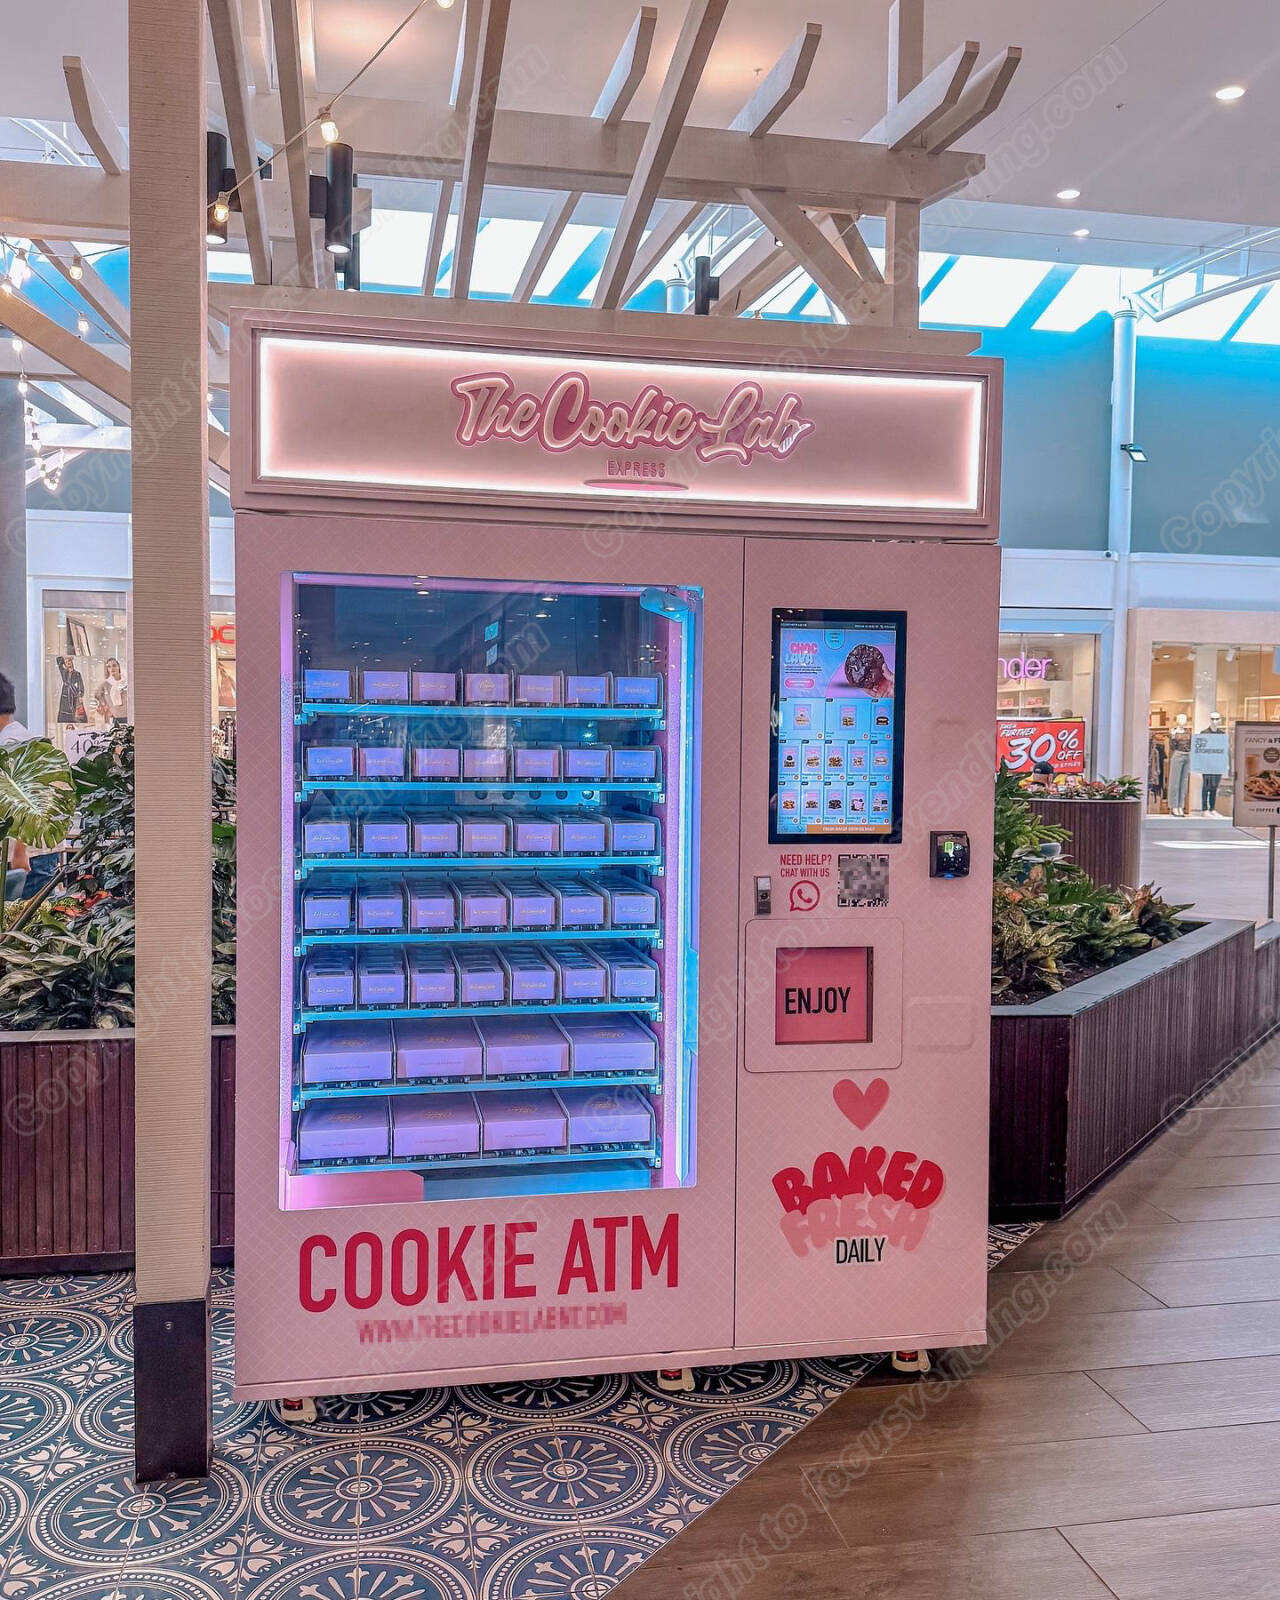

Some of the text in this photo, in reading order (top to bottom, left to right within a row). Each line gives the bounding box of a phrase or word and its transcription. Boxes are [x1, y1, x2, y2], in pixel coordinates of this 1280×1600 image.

[451, 371, 815, 466] The Cookie Lab
[607, 460, 666, 478] EXPRESS
[1056, 750, 1083, 761] OFF
[780, 853, 832, 866] NEED HELP?
[780, 867, 830, 878] CHAT WITH US
[785, 986, 851, 1014] ENJOY
[772, 1145, 944, 1216] BAKED
[780, 1193, 930, 1257] FRESH
[299, 1221, 538, 1313] COOKIE
[556, 1213, 679, 1295] ATM
[836, 1237, 886, 1264] DAILY
